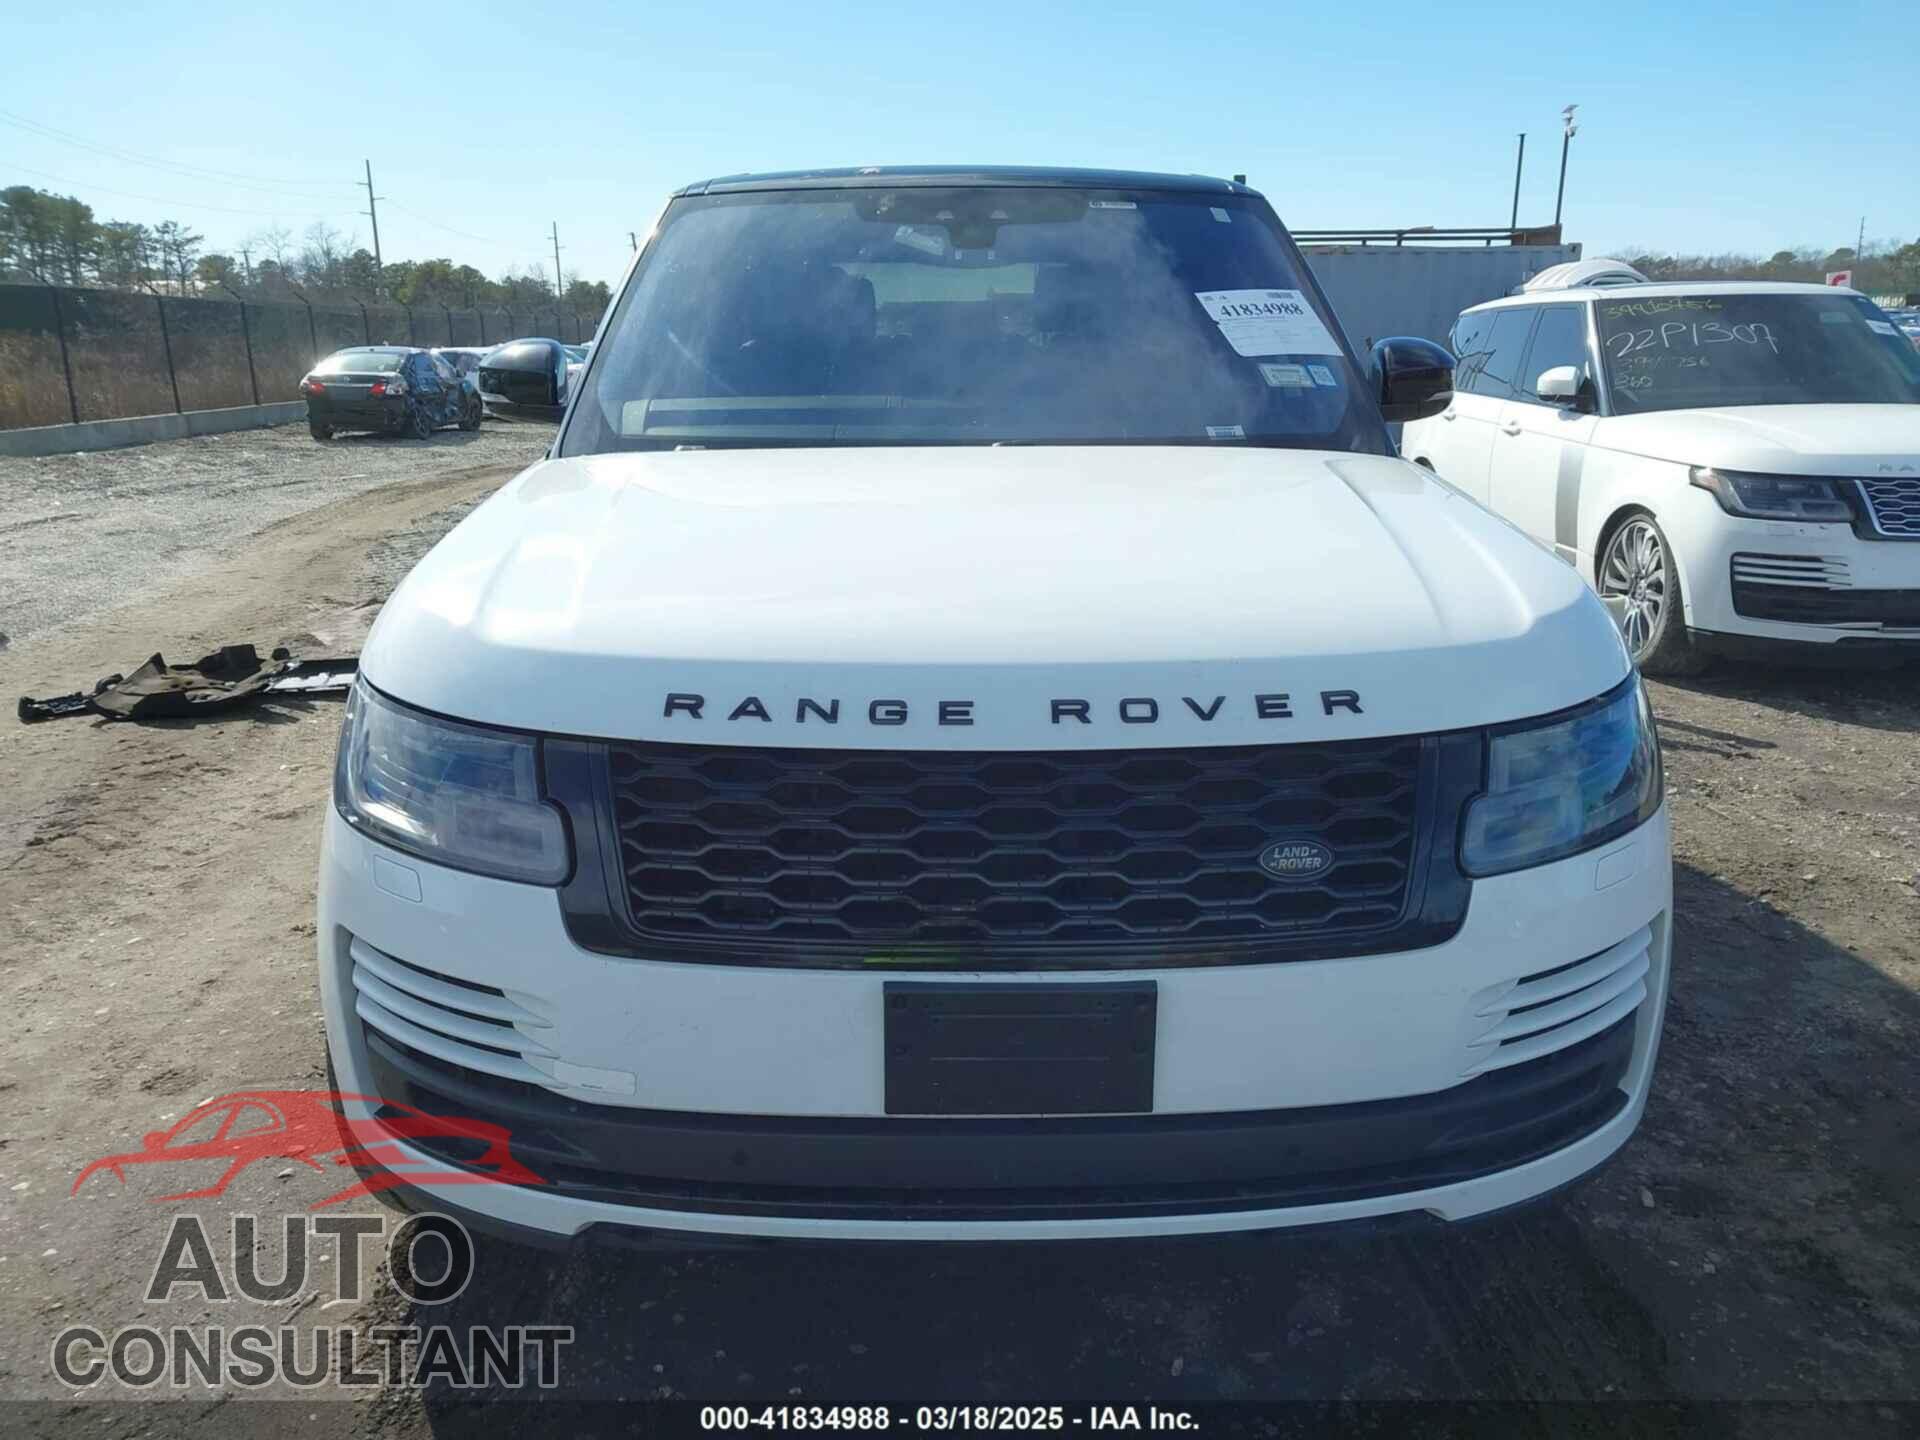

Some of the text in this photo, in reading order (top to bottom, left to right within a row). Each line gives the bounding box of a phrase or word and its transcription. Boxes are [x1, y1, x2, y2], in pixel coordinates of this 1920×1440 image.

[1220, 302, 1304, 318] 41834988
[663, 689, 1364, 726] RANGE ROVER
